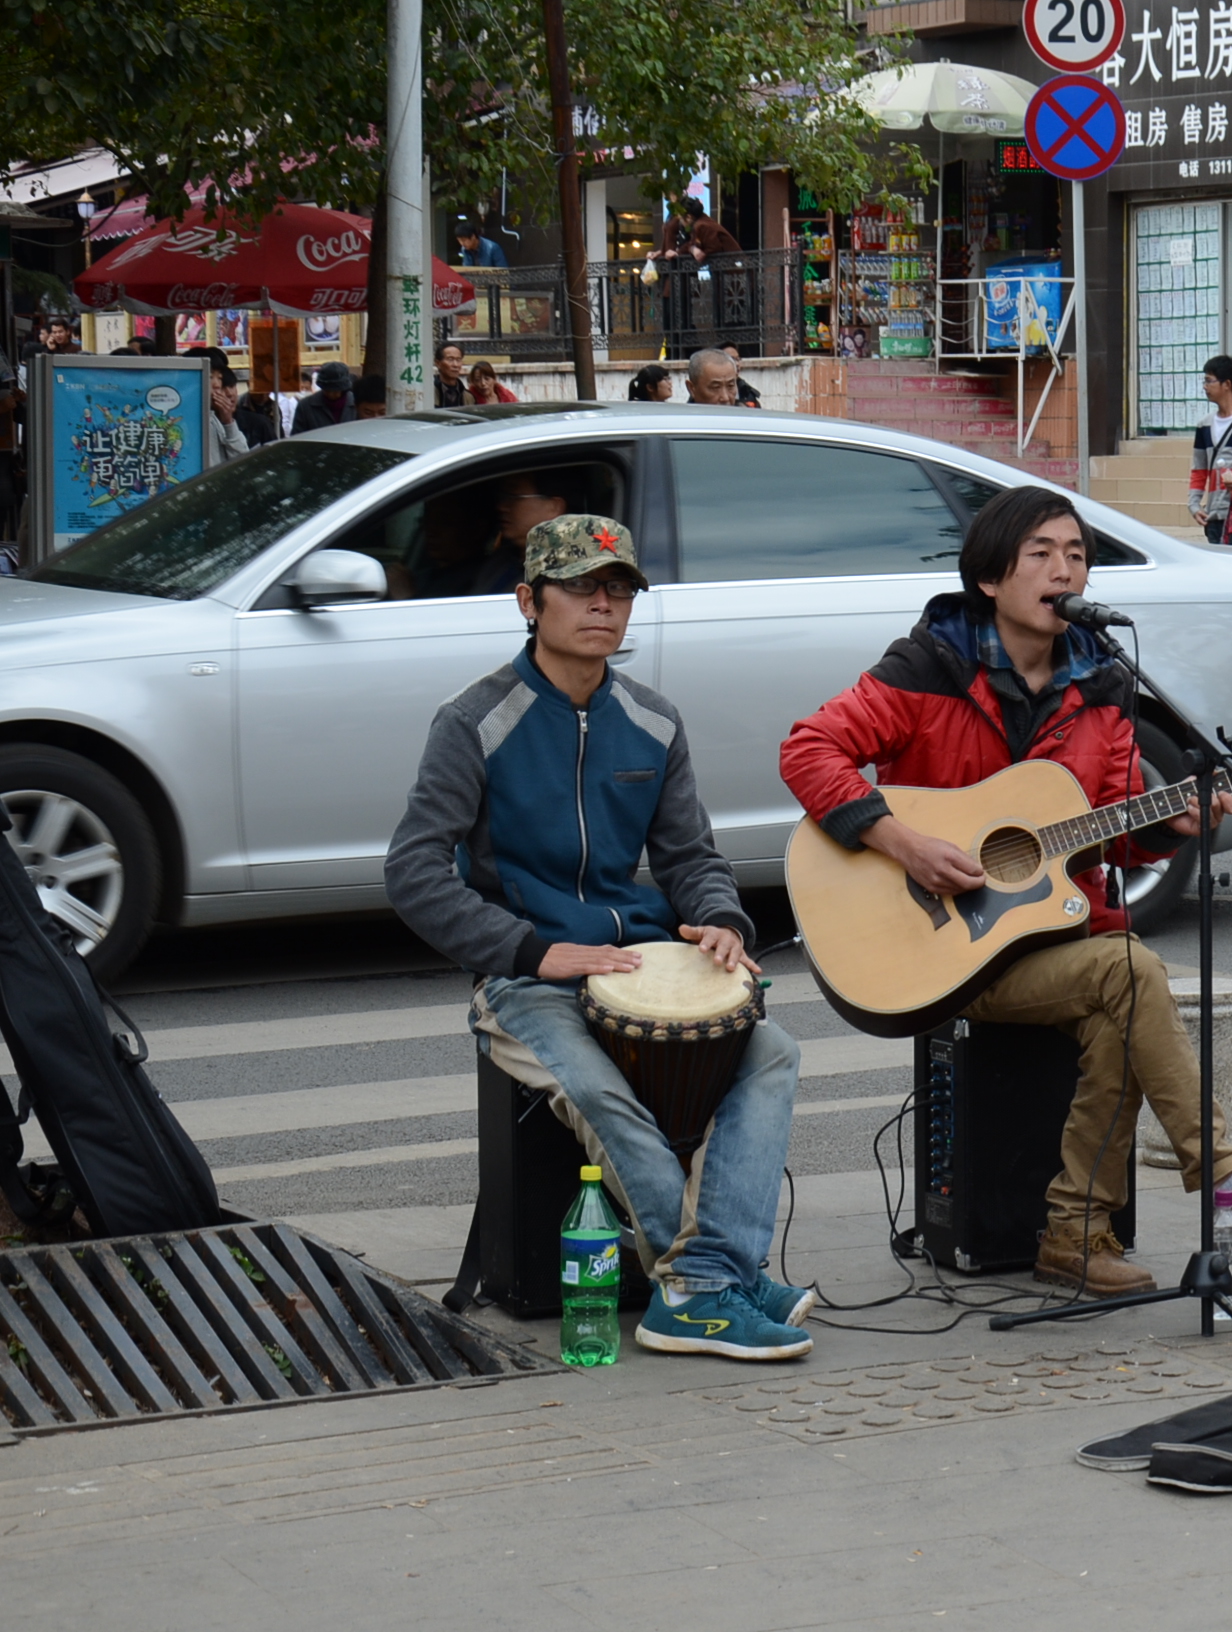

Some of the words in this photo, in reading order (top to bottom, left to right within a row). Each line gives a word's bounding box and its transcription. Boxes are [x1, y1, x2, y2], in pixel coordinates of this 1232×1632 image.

[1047, 0, 1105, 43] 20
[1125, 107, 1168, 148] 租房
[1180, 102, 1228, 145] 售房
[1179, 161, 1199, 177] 电话
[296, 230, 369, 272] Coca
[400, 365, 423, 384] 42
[82, 421, 166, 455] 让健康
[91, 454, 161, 487] 更简单
